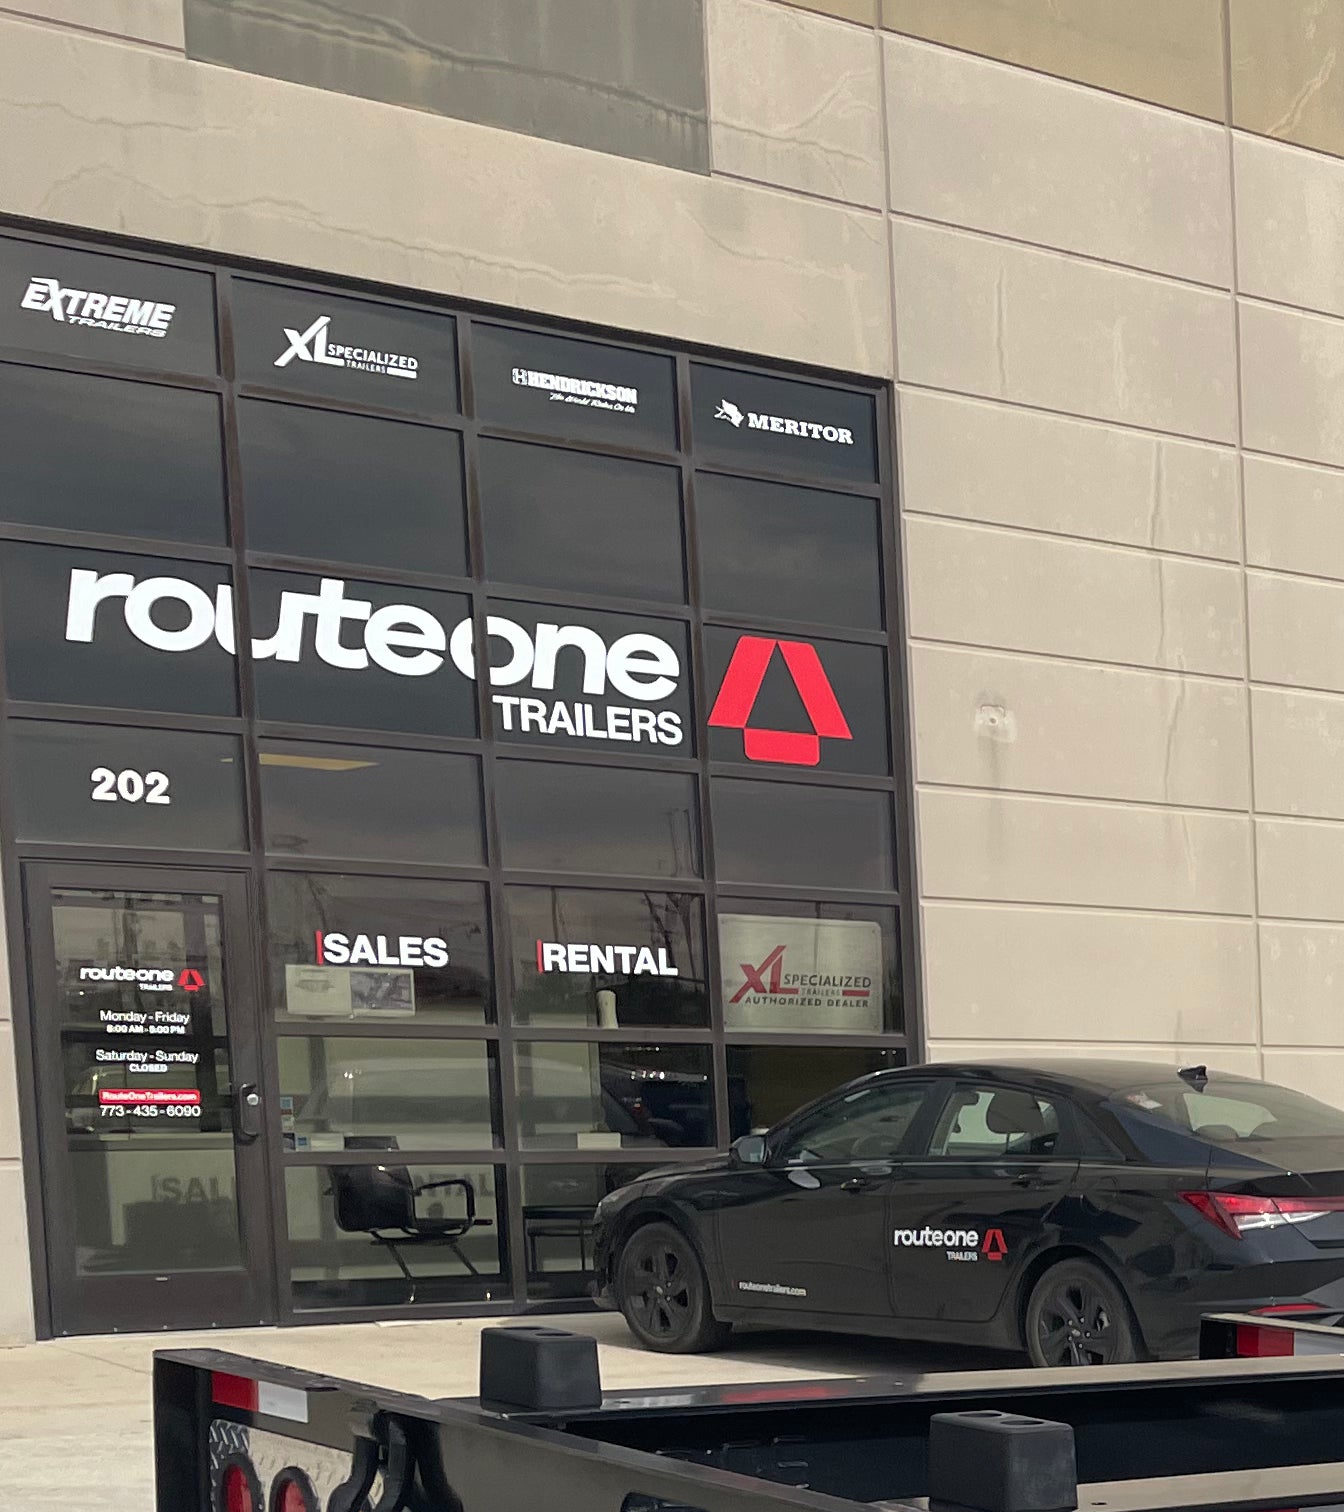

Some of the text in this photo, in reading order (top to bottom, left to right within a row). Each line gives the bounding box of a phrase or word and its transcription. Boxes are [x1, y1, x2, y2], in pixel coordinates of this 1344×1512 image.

[21, 277, 176, 330] EXTREME
[68, 316, 167, 338] TRAILERS
[273, 316, 418, 371] XL SPECIALIZED
[345, 362, 386, 374] TRAILERS
[748, 413, 854, 445] MERITOR
[65, 567, 679, 701] routeone
[493, 696, 684, 746] TRAILERS
[91, 767, 170, 805] 202
[323, 932, 449, 968] SALES
[543, 941, 679, 977] RENTAL
[80, 966, 175, 982] routeone
[729, 945, 872, 1004] XL SPECIALIZED
[100, 1010, 147, 1025] Monday
[155, 1011, 190, 1025] Friday
[745, 996, 869, 1009] AUTHORIZED DEALER
[96, 1049, 148, 1063] Saturday
[155, 1050, 199, 1064] Sunday
[894, 1226, 979, 1247] routeone
